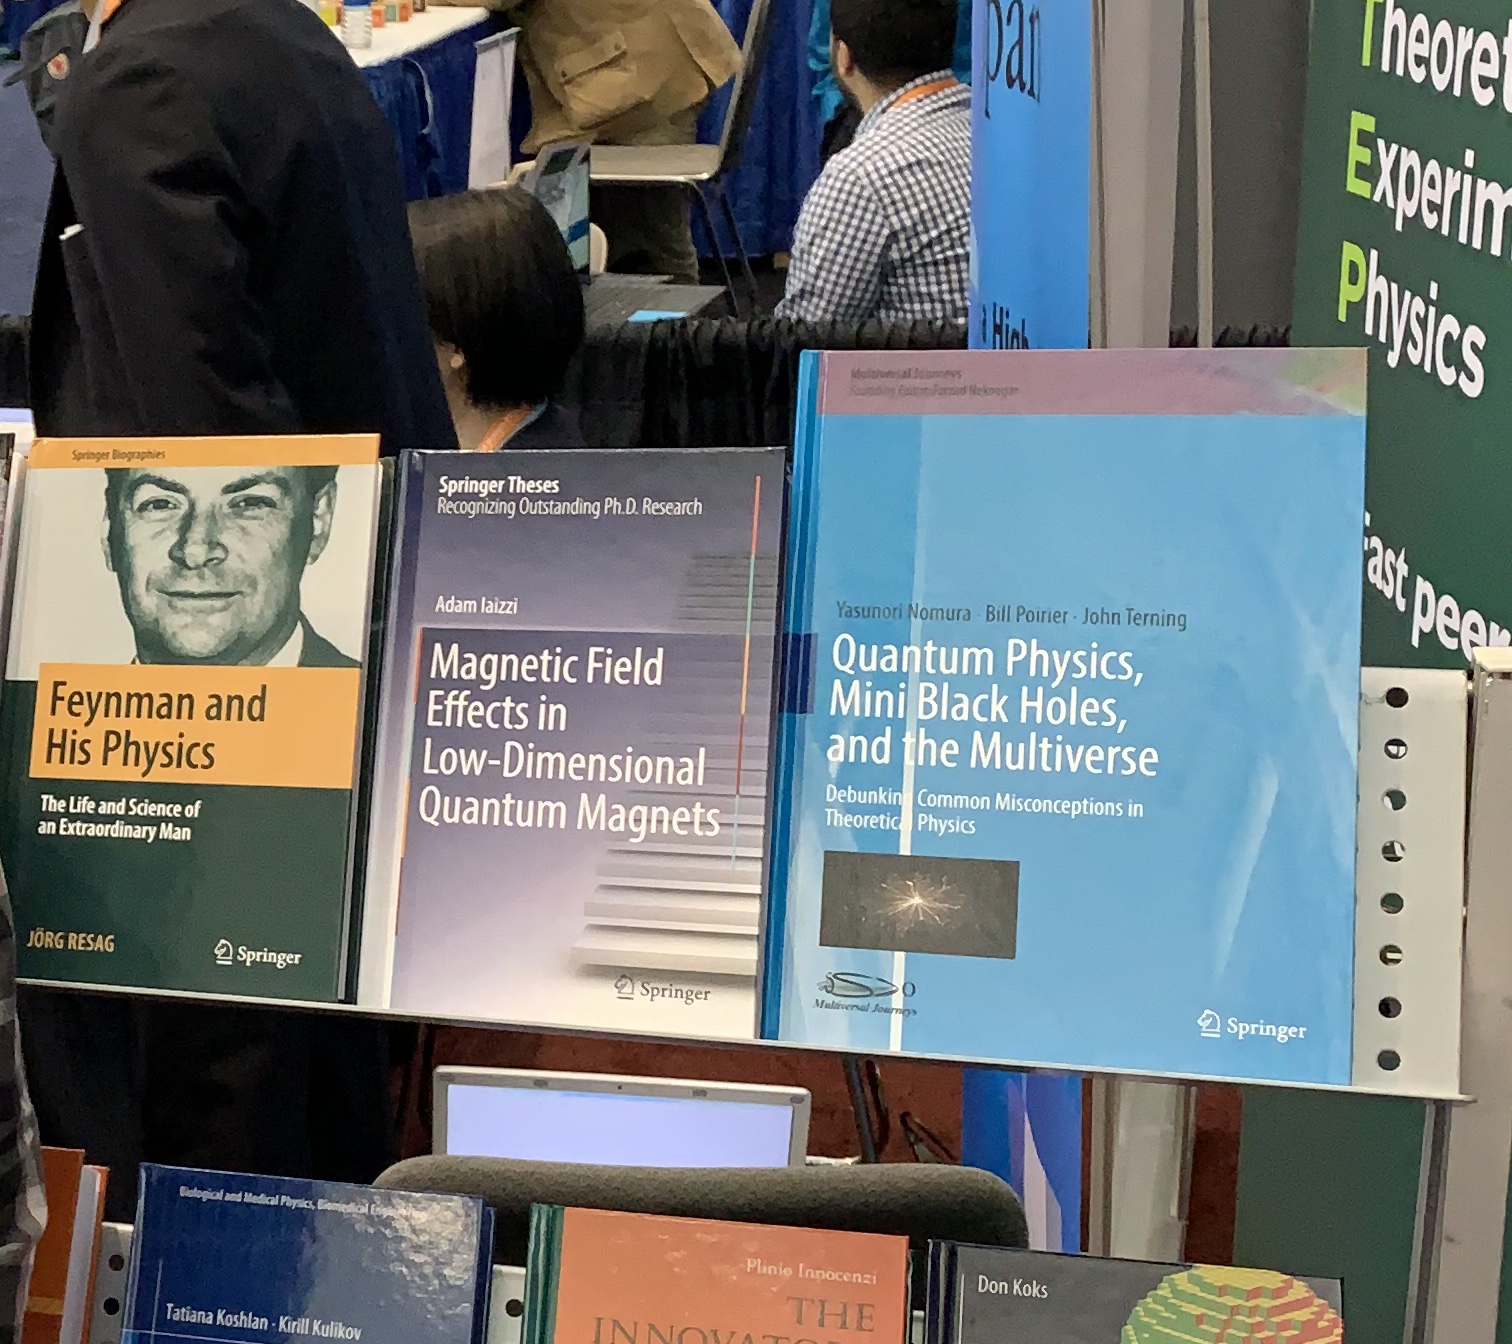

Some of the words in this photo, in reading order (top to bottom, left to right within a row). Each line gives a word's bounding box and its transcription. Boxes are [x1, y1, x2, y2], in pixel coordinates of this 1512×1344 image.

[1338, 240, 1486, 400] Physics
[438, 476, 506, 498] Springer
[506, 475, 561, 494] Theses
[437, 496, 517, 520] Recognizing
[518, 497, 601, 520] Outstanding
[603, 497, 639, 516] Ph.D.
[641, 497, 704, 516] Research
[434, 596, 478, 614] Adam
[480, 596, 519, 616] Iaizzi
[429, 642, 579, 692] Magnetic
[586, 645, 665, 687] Field
[831, 632, 995, 676] Quantum
[1006, 637, 1145, 689] Physics,
[49, 680, 195, 728] Feynman
[204, 684, 268, 723] and
[426, 689, 529, 732] Effects
[537, 694, 569, 732] in
[829, 678, 907, 720] Mini
[916, 681, 1009, 724] Black
[1019, 683, 1128, 734] Holes,
[44, 727, 92, 766] His
[101, 729, 216, 778] Physics
[422, 736, 707, 787] Low-Dimensional
[826, 725, 892, 766] and
[901, 726, 961, 768] the
[969, 729, 1160, 778] Multiverse
[40, 794, 66, 814] The
[68, 796, 96, 814] Life
[97, 798, 126, 816] and
[127, 797, 183, 818] Science
[184, 799, 203, 819] of
[418, 784, 567, 829] Quantum
[576, 792, 722, 844] Magnets
[37, 820, 57, 835] an
[58, 818, 158, 844] Extraordinary
[158, 822, 192, 841] Man
[26, 927, 65, 950] JÖRG
[67, 932, 116, 953] RESAG
[236, 946, 303, 969] Springer
[639, 980, 711, 1006] Springer
[1226, 1014, 1308, 1044] Springer
[977, 1274, 1009, 1296] Don
[1012, 1277, 1049, 1300] Koks
[164, 1302, 214, 1325] Tatiana
[216, 1309, 269, 1331] Koshlan
[278, 1315, 309, 1336] Kirill
[312, 1319, 363, 1341] Kulikov
[786, 1296, 876, 1333] THE
